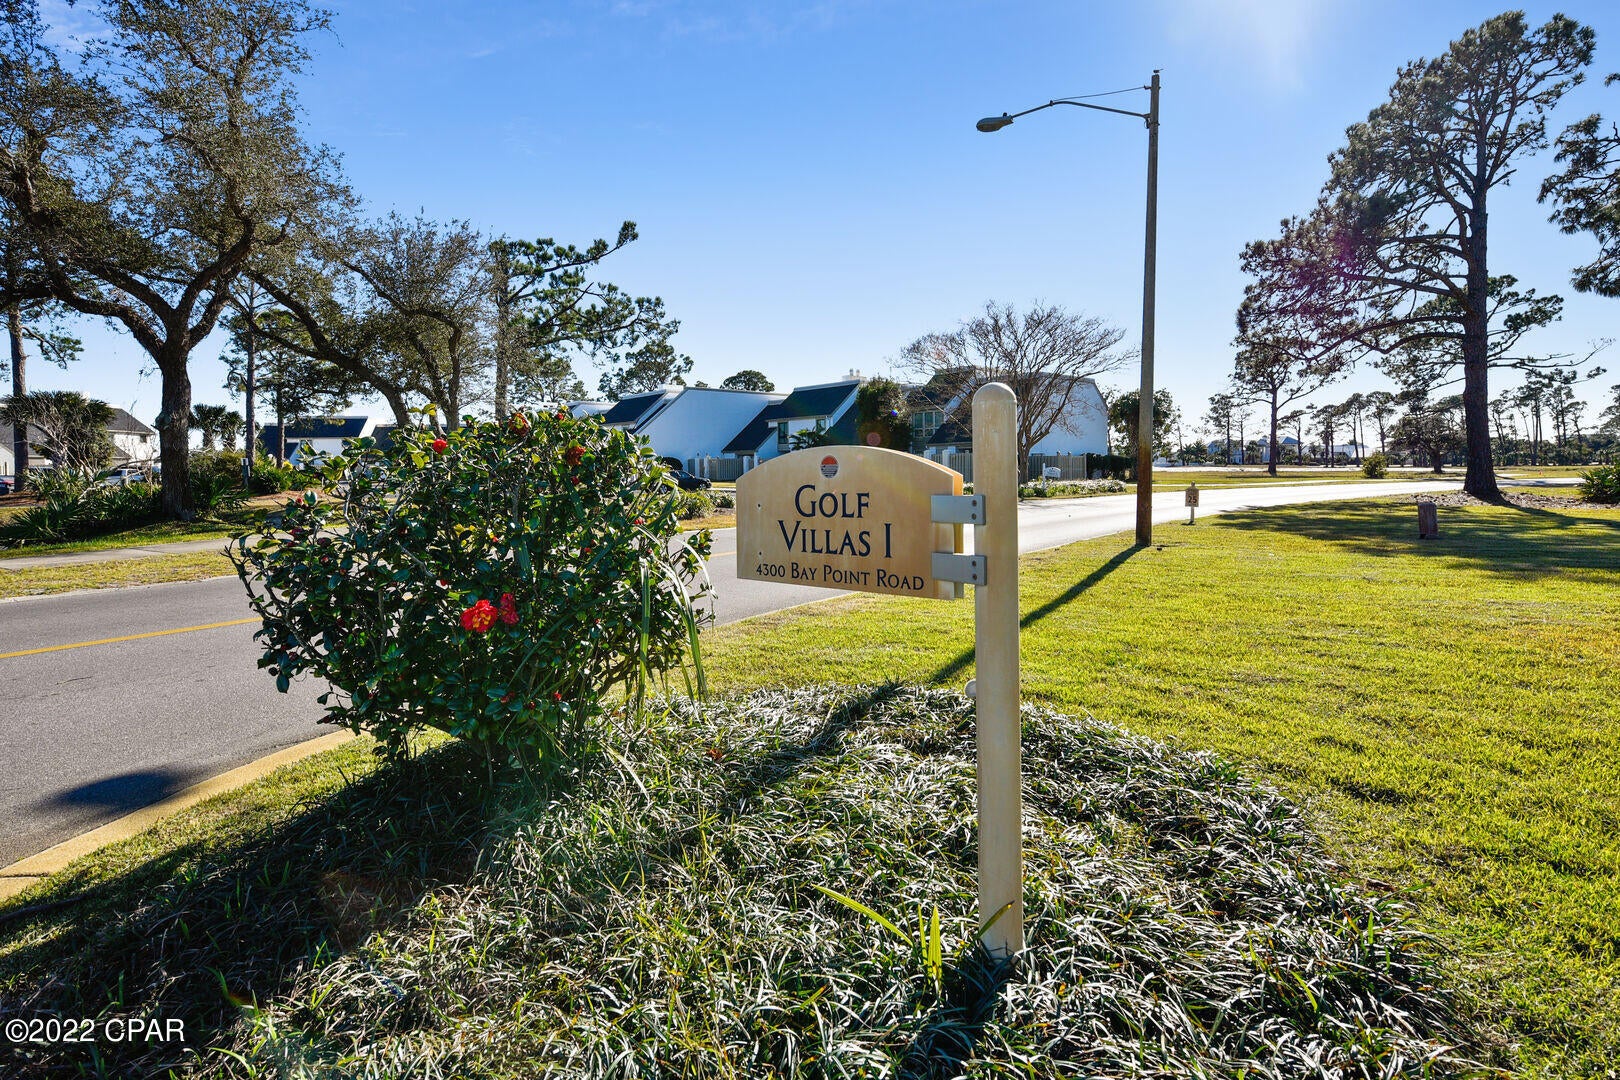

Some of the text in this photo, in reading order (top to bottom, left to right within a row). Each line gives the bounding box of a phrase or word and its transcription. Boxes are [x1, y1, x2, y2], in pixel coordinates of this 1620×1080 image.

[794, 484, 870, 519] GOLF
[1188, 495, 1198, 503] 25
[778, 520, 892, 558] VILLAS I
[756, 562, 924, 591] 4300 BAY POINT ROAD
